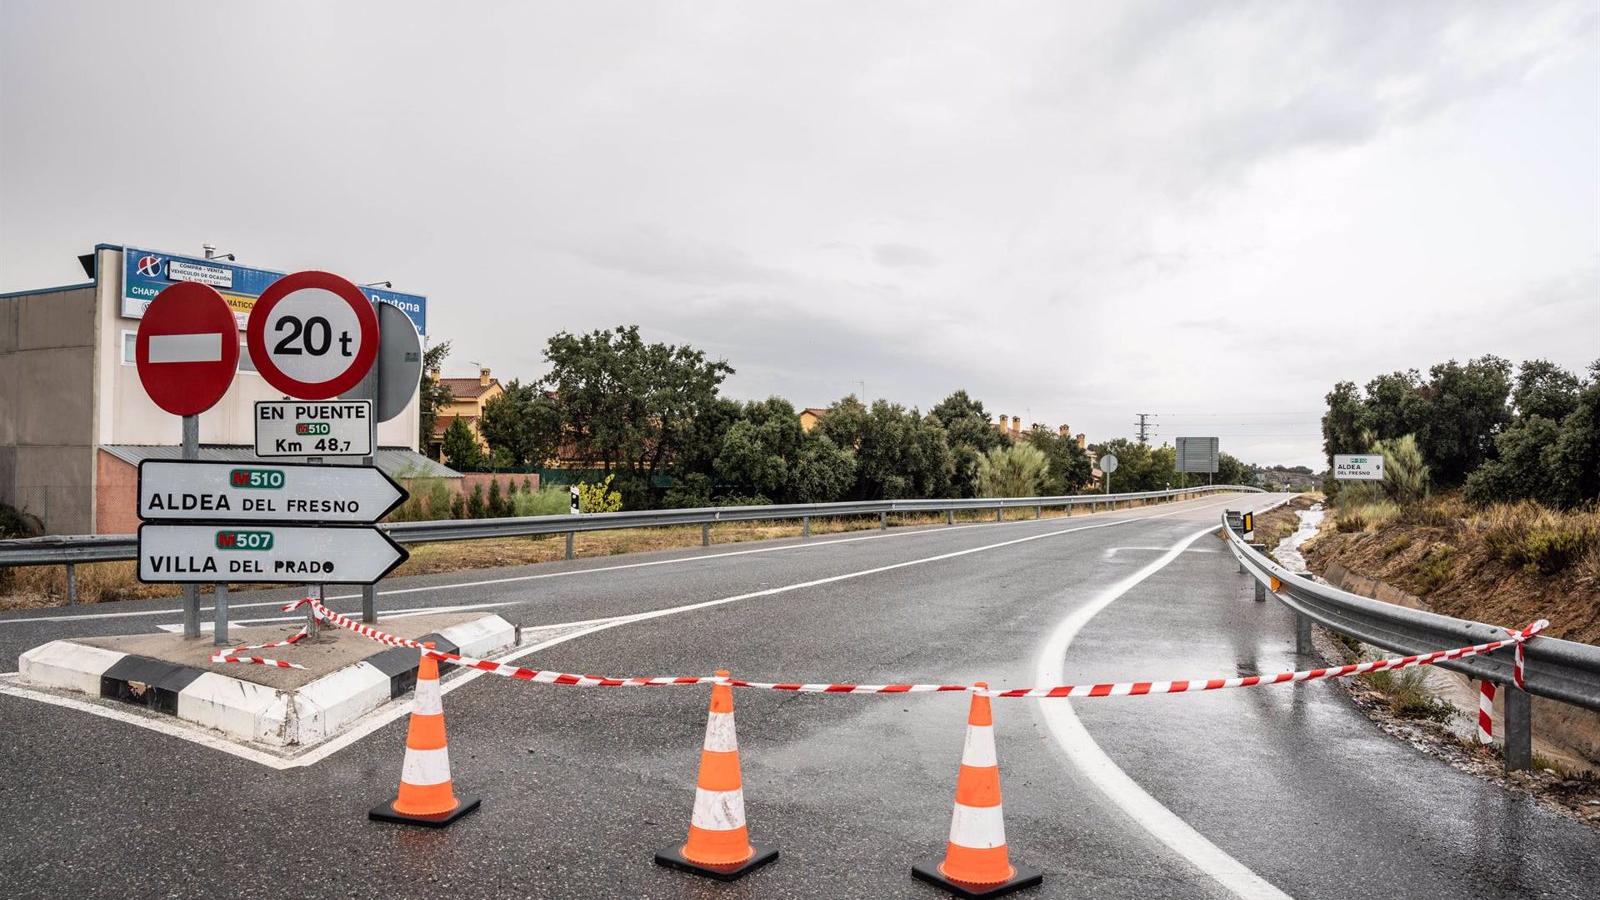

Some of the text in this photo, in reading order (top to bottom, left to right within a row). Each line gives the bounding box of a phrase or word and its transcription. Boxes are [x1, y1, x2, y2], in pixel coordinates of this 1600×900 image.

[273, 315, 352, 357] 20 t
[260, 406, 365, 419] EN PUENTE
[276, 438, 302, 452] Km
[232, 471, 282, 487] M510
[148, 493, 359, 513] ALDEA DEL FRESNO
[217, 532, 271, 549] M507
[150, 556, 335, 574] VILLA DEL PRADO
